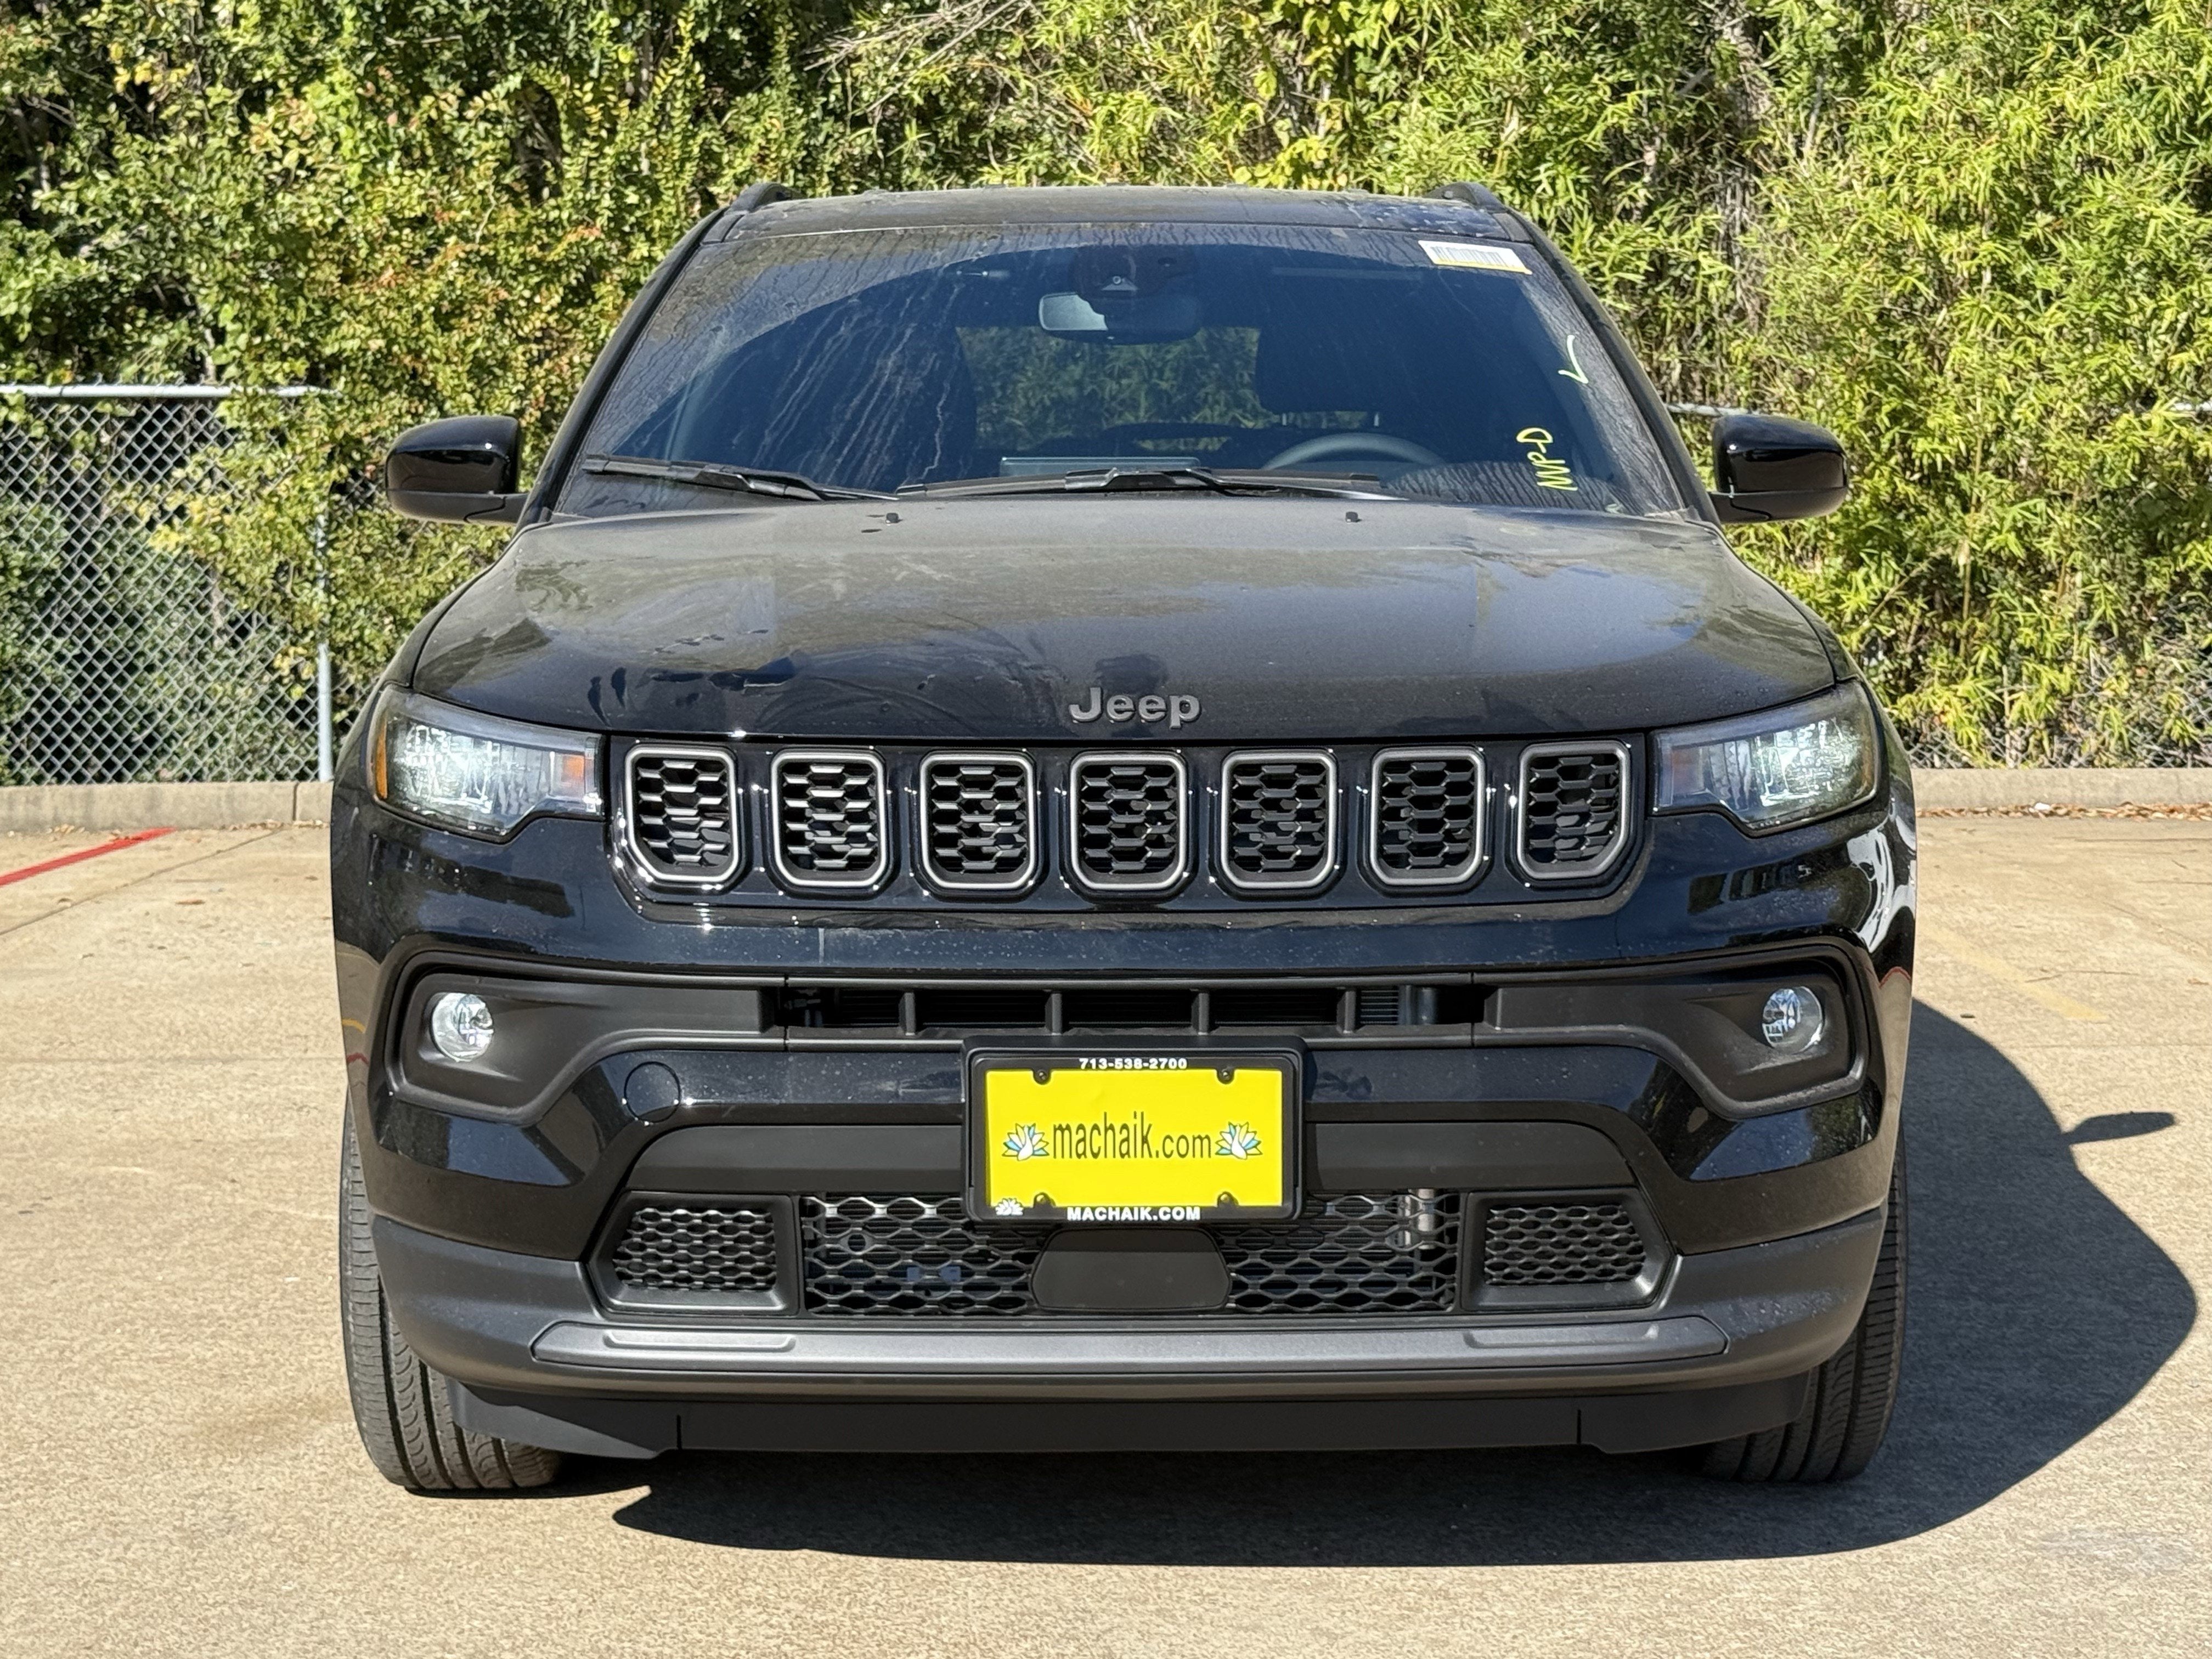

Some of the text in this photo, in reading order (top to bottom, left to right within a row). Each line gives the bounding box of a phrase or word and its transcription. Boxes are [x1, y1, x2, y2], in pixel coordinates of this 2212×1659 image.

[1069, 687, 1200, 729] Jeep
[1079, 1058, 1188, 1070] 713-538-2700
[1053, 1111, 1212, 1159] machaik.com
[1067, 1206, 1200, 1221] MACHAIK.COM
